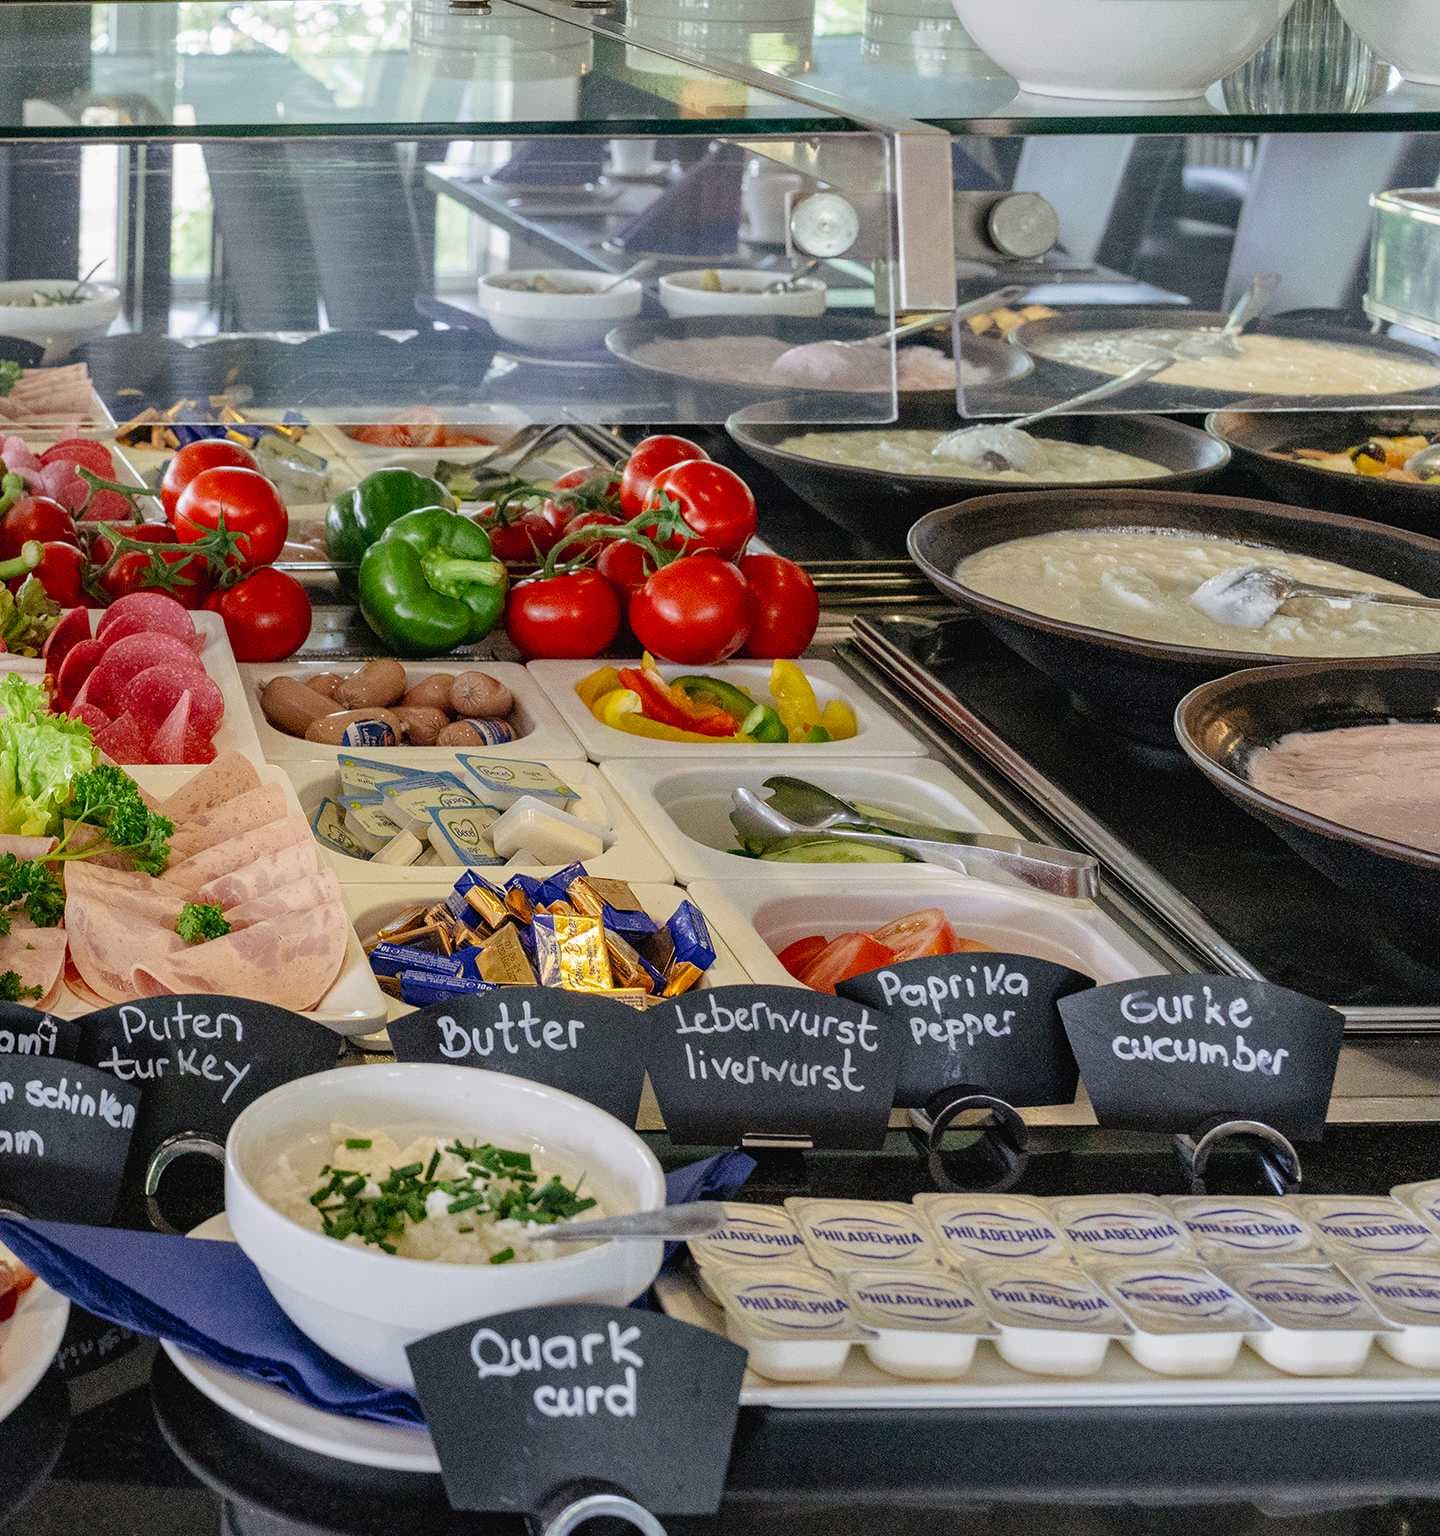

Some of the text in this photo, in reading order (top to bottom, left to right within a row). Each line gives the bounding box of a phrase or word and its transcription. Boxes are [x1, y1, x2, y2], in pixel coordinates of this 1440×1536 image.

[119, 1001, 244, 1044] Puten
[436, 1001, 585, 1060] Butter
[911, 1010, 1017, 1051] pepper
[1112, 1035, 1290, 1076] cucumber
[686, 1043, 866, 1093] liverwurst
[810, 1225, 923, 1246] PHILADELPHIA
[941, 1224, 1056, 1243] PHILADELPHIA
[1064, 1223, 1179, 1243] PHILADELPHIA
[1184, 1220, 1302, 1237] PHILADELPHIA
[1317, 1221, 1432, 1239] PHILADELPHIA
[737, 1294, 850, 1315] PHILADELPHIA
[856, 1290, 975, 1310] PHILADELPHIA
[988, 1287, 1109, 1311] PHILADELPHIA
[470, 1320, 644, 1379] Quark
[533, 1366, 637, 1418] curd
